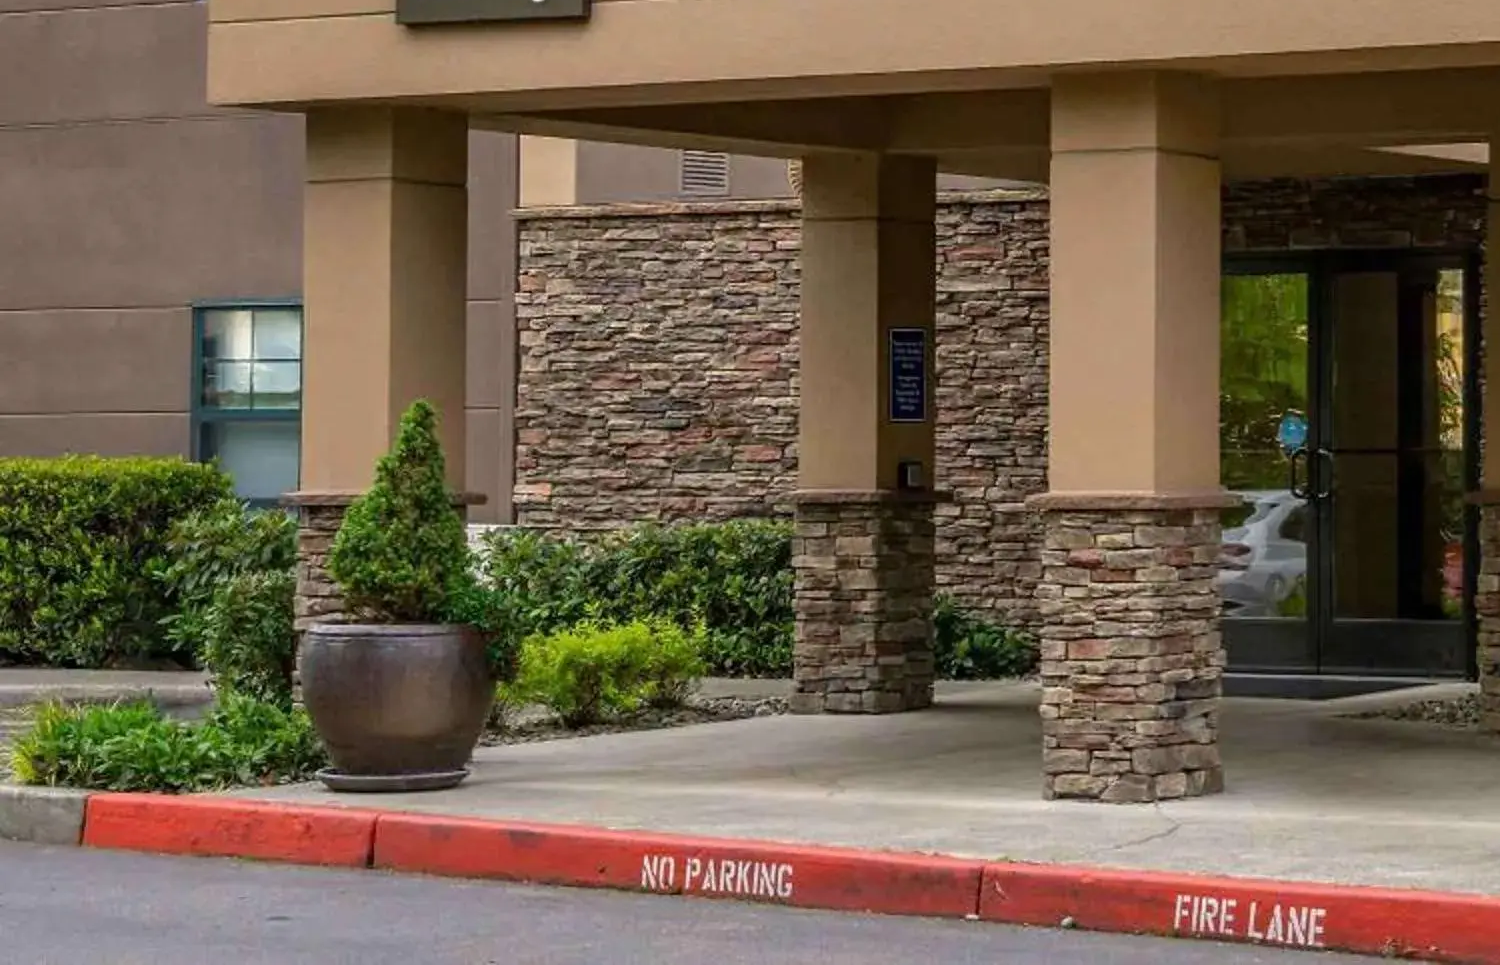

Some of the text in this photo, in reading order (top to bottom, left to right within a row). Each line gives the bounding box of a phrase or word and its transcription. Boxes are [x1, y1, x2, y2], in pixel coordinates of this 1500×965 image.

[641, 855, 794, 897] NO PARKING
[1174, 894, 1327, 946] FIRE LANE
